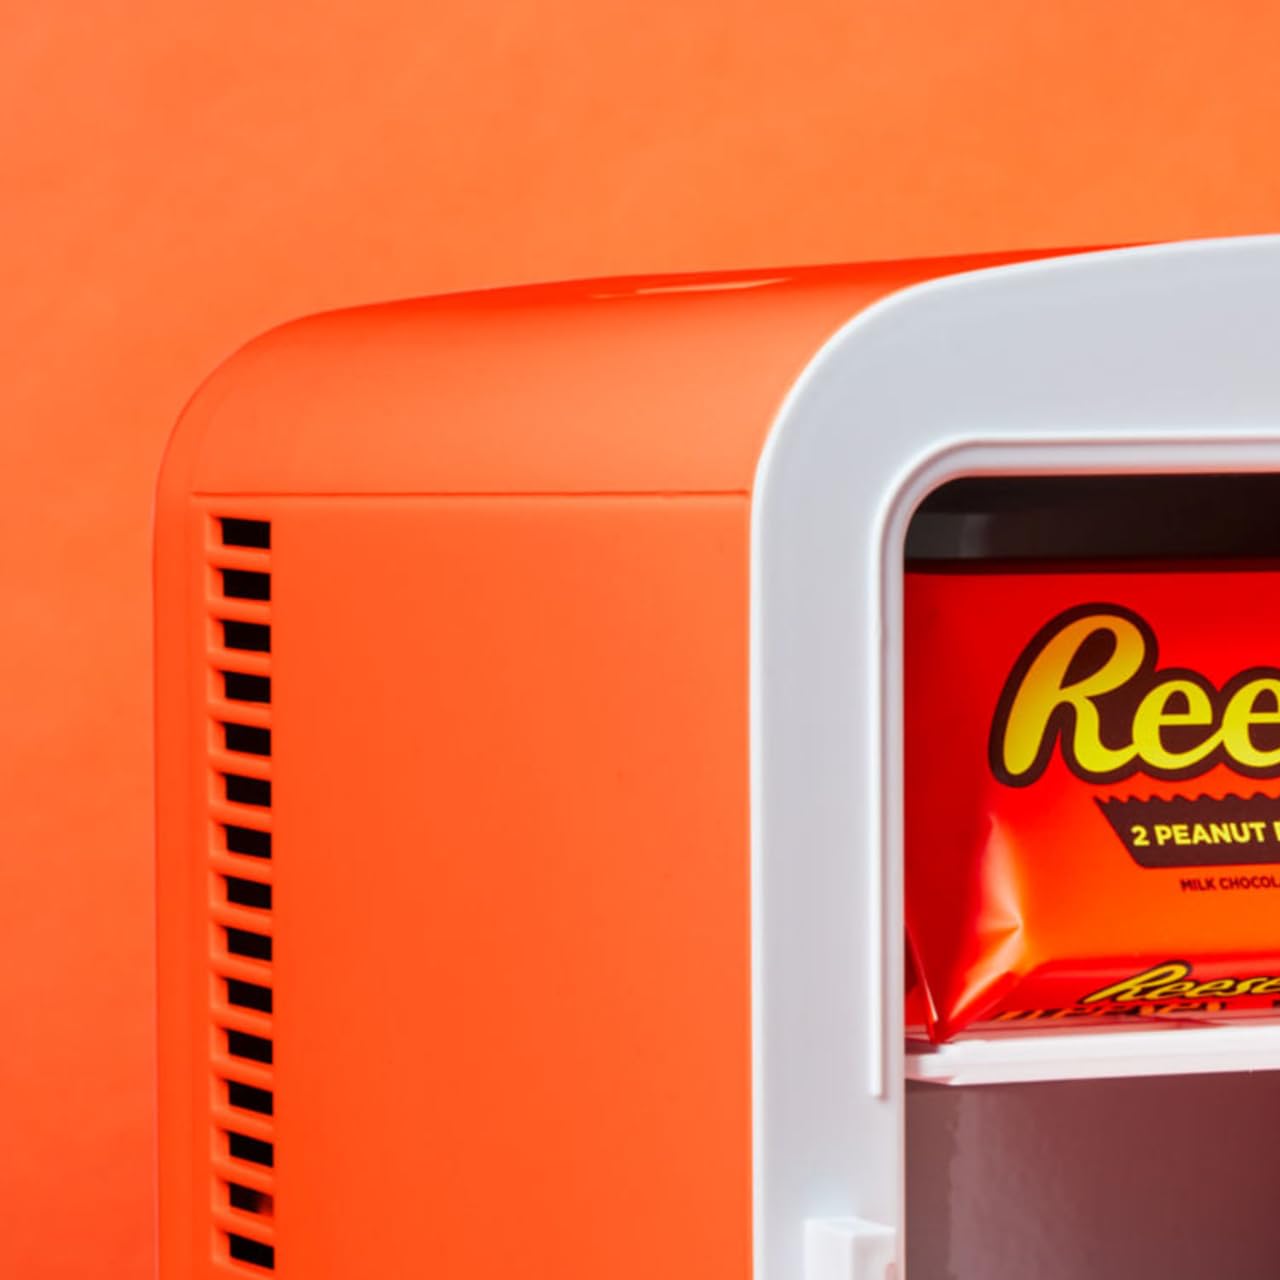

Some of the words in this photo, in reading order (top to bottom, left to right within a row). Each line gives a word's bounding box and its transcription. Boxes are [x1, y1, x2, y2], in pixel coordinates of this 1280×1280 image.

[1131, 825, 1151, 847] 2
[1154, 821, 1267, 847] PEANUT
[1180, 876, 1216, 892] MILK
